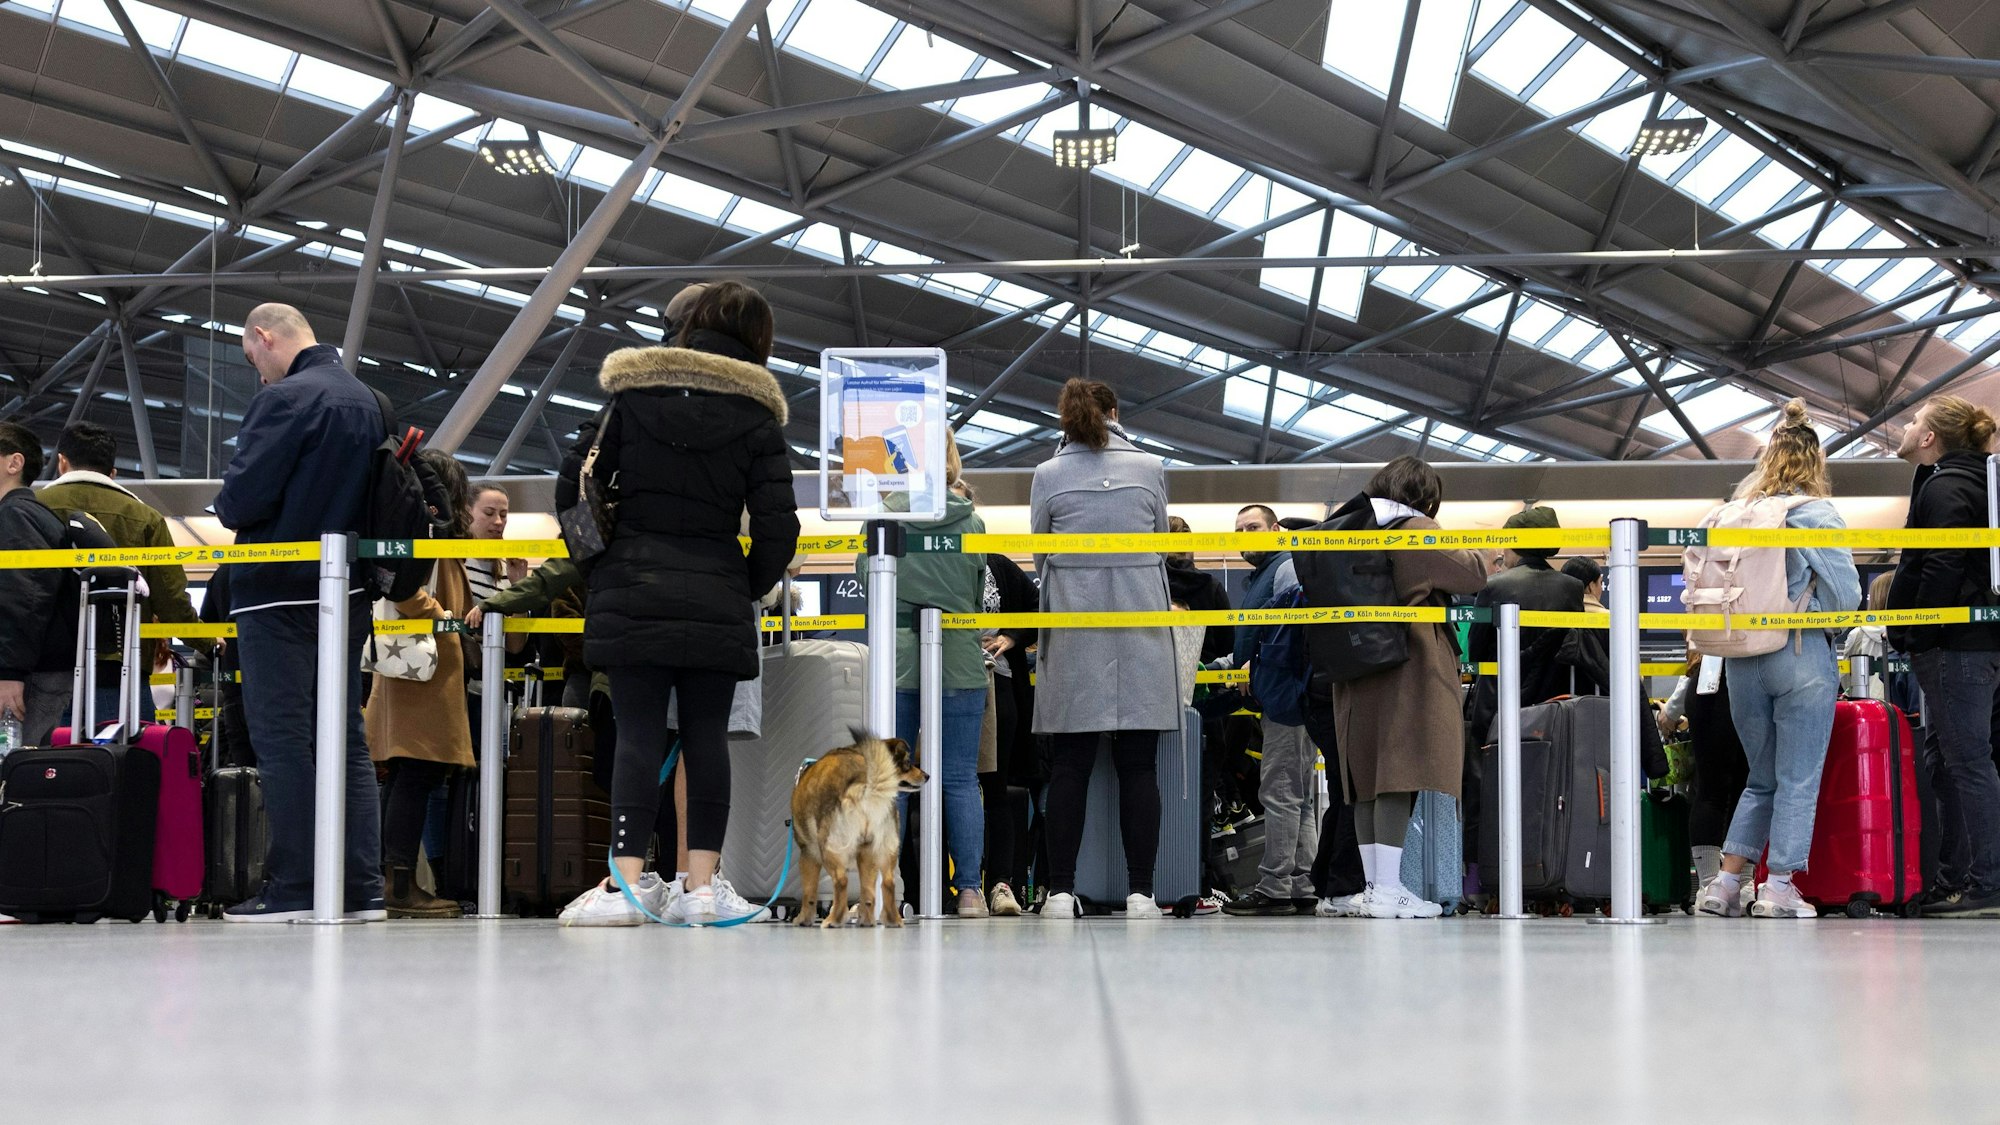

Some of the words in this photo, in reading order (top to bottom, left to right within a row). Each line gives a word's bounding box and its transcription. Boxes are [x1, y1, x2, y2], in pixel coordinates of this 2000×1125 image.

[1302, 537, 1321, 545] Köln
[1324, 537, 1344, 545] Bonn
[1348, 537, 1380, 546] Airport
[1440, 536, 1459, 544] Köln
[1462, 535, 1482, 544] Bonn
[1485, 535, 1518, 545] Airport
[248, 549, 267, 557] Bonn
[270, 548, 300, 557] Airport
[99, 553, 116, 561] Köln
[120, 553, 138, 561] Bonn
[141, 553, 171, 562] Airport
[1283, 612, 1309, 620] Airport
[1392, 610, 1418, 618] Airport
[1915, 613, 1940, 621] Airport
[812, 619, 837, 627] Airport
[951, 617, 976, 625] Airport
[1806, 616, 1831, 624] Airport
